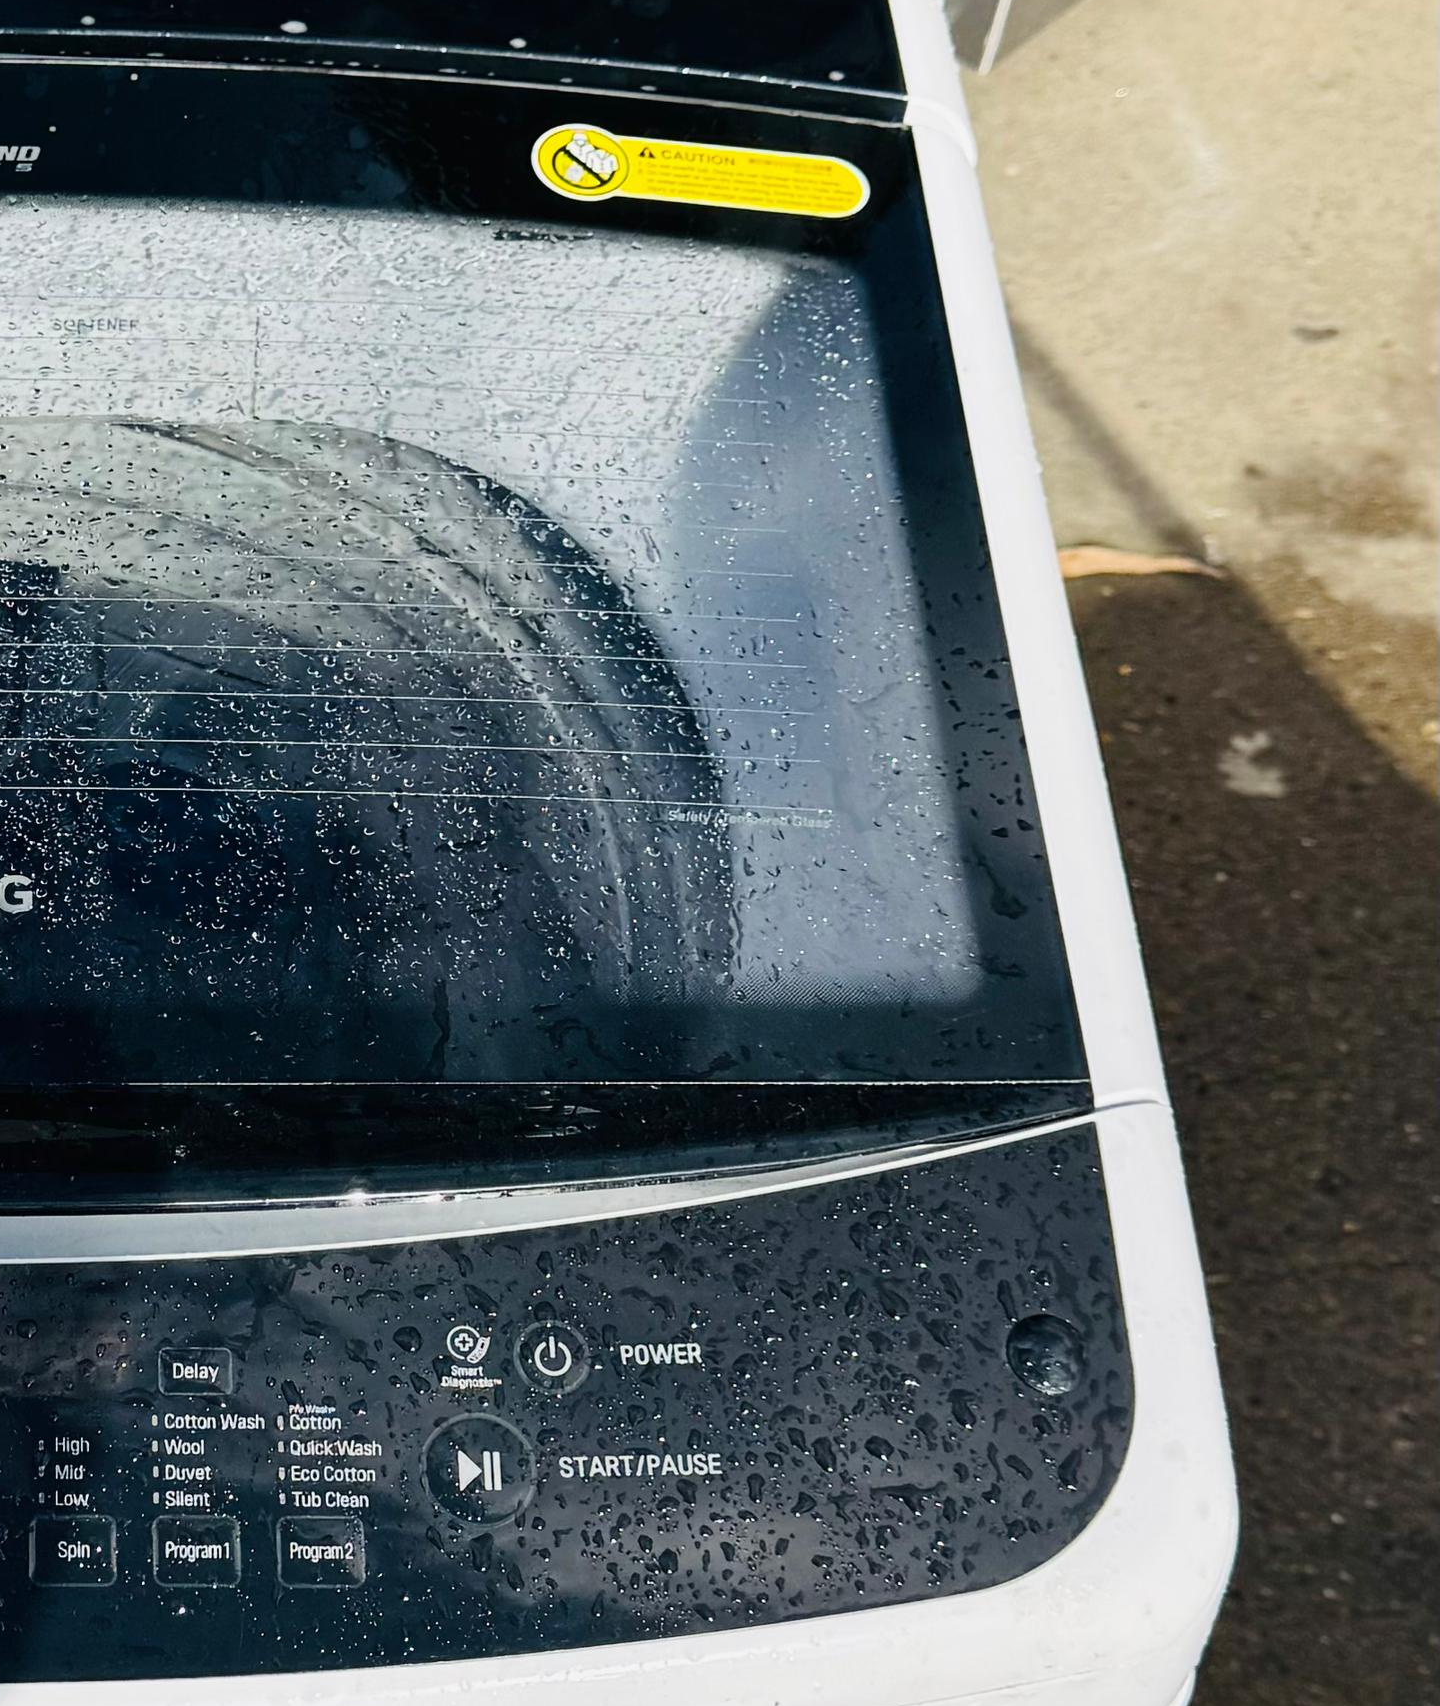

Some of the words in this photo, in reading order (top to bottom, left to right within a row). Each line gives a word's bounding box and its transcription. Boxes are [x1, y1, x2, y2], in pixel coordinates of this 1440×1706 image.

[661, 149, 735, 166] CAUTION
[620, 1343, 703, 1366] POWER
[172, 1362, 219, 1383] Delay
[451, 1365, 484, 1377] Smart
[164, 1413, 216, 1430] Cotton
[220, 1413, 266, 1430] Wash
[289, 1414, 342, 1430] Cotton
[55, 1437, 90, 1456] High
[164, 1439, 205, 1455] Wool
[290, 1440, 335, 1456] Quick
[337, 1440, 382, 1456] Wash
[55, 1464, 85, 1480] Mid
[164, 1465, 212, 1481] Duvet
[291, 1465, 319, 1482] Eco
[324, 1465, 376, 1482] Cotton
[559, 1453, 723, 1479] START/PAUSE
[55, 1490, 89, 1506] Low
[165, 1491, 210, 1507] Silent
[293, 1491, 321, 1507] Tub
[325, 1491, 369, 1507] Clean
[57, 1541, 91, 1563] Spin
